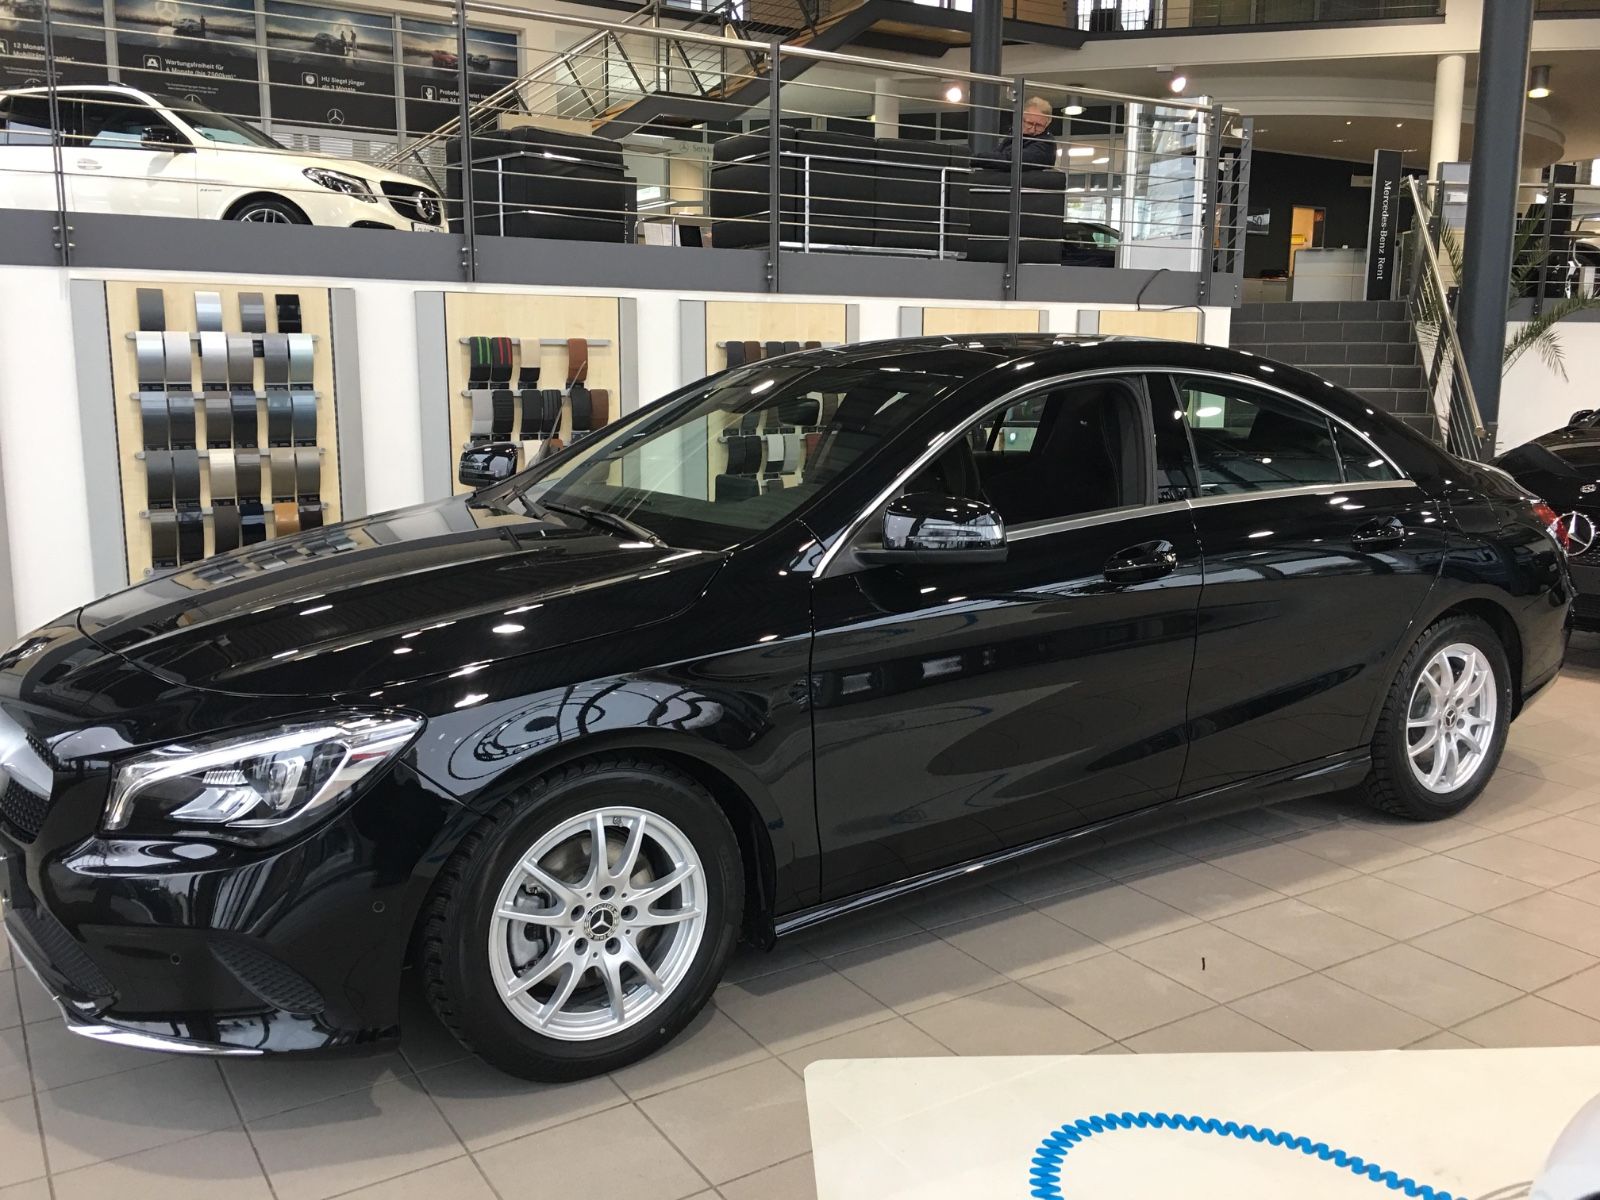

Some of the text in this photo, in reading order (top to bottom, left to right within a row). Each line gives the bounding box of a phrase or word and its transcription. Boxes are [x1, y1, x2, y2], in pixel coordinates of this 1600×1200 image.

[215, 63, 225, 71] für
[1376, 180, 1392, 280] Mercedes-Benz Rent
